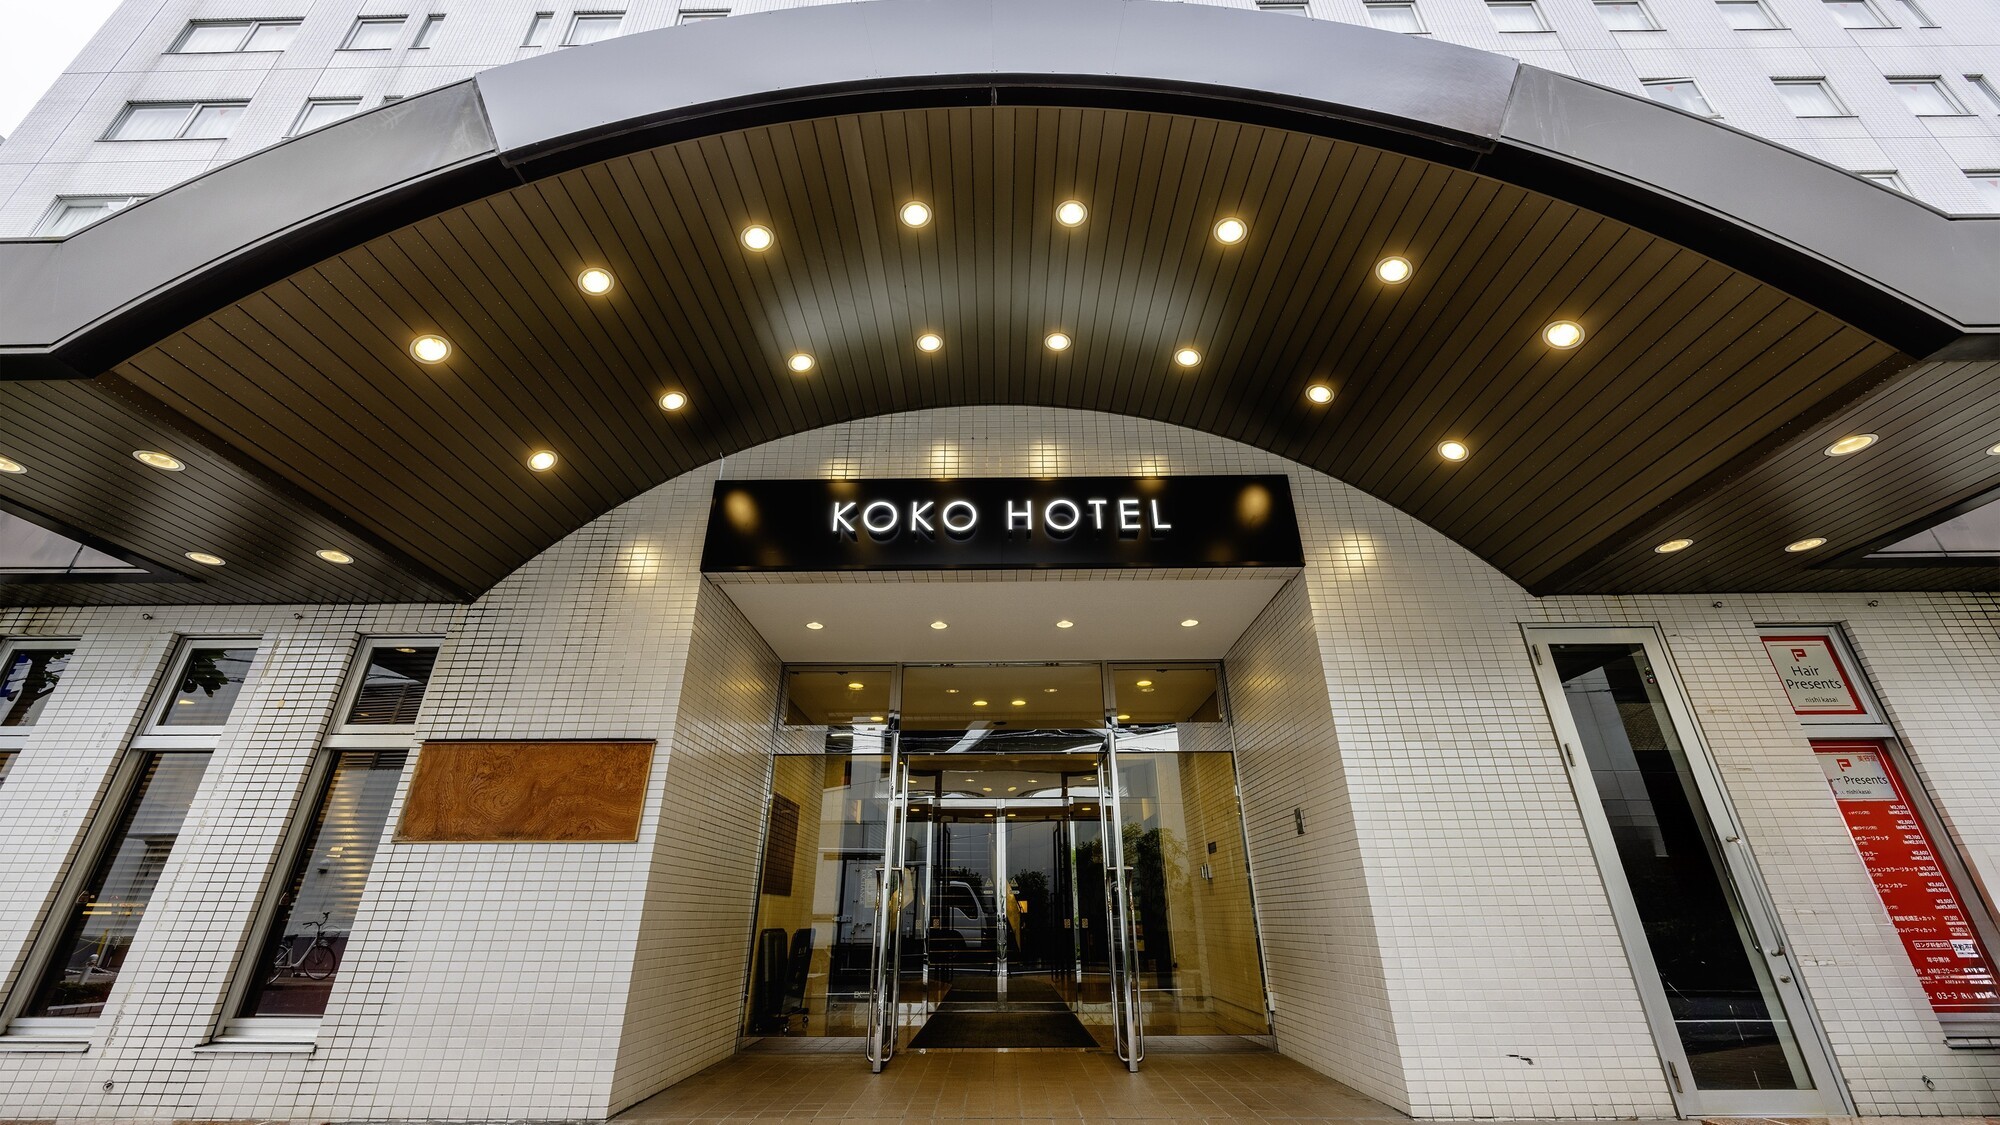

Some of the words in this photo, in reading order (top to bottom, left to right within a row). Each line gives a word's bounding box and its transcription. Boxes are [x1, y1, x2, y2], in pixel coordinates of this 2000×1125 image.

[832, 500, 978, 532] KOKO
[1007, 499, 1172, 530] HOTEL
[1791, 665, 1819, 676] Hair
[1785, 678, 1842, 690] Presents
[1843, 775, 1888, 785] Presents
